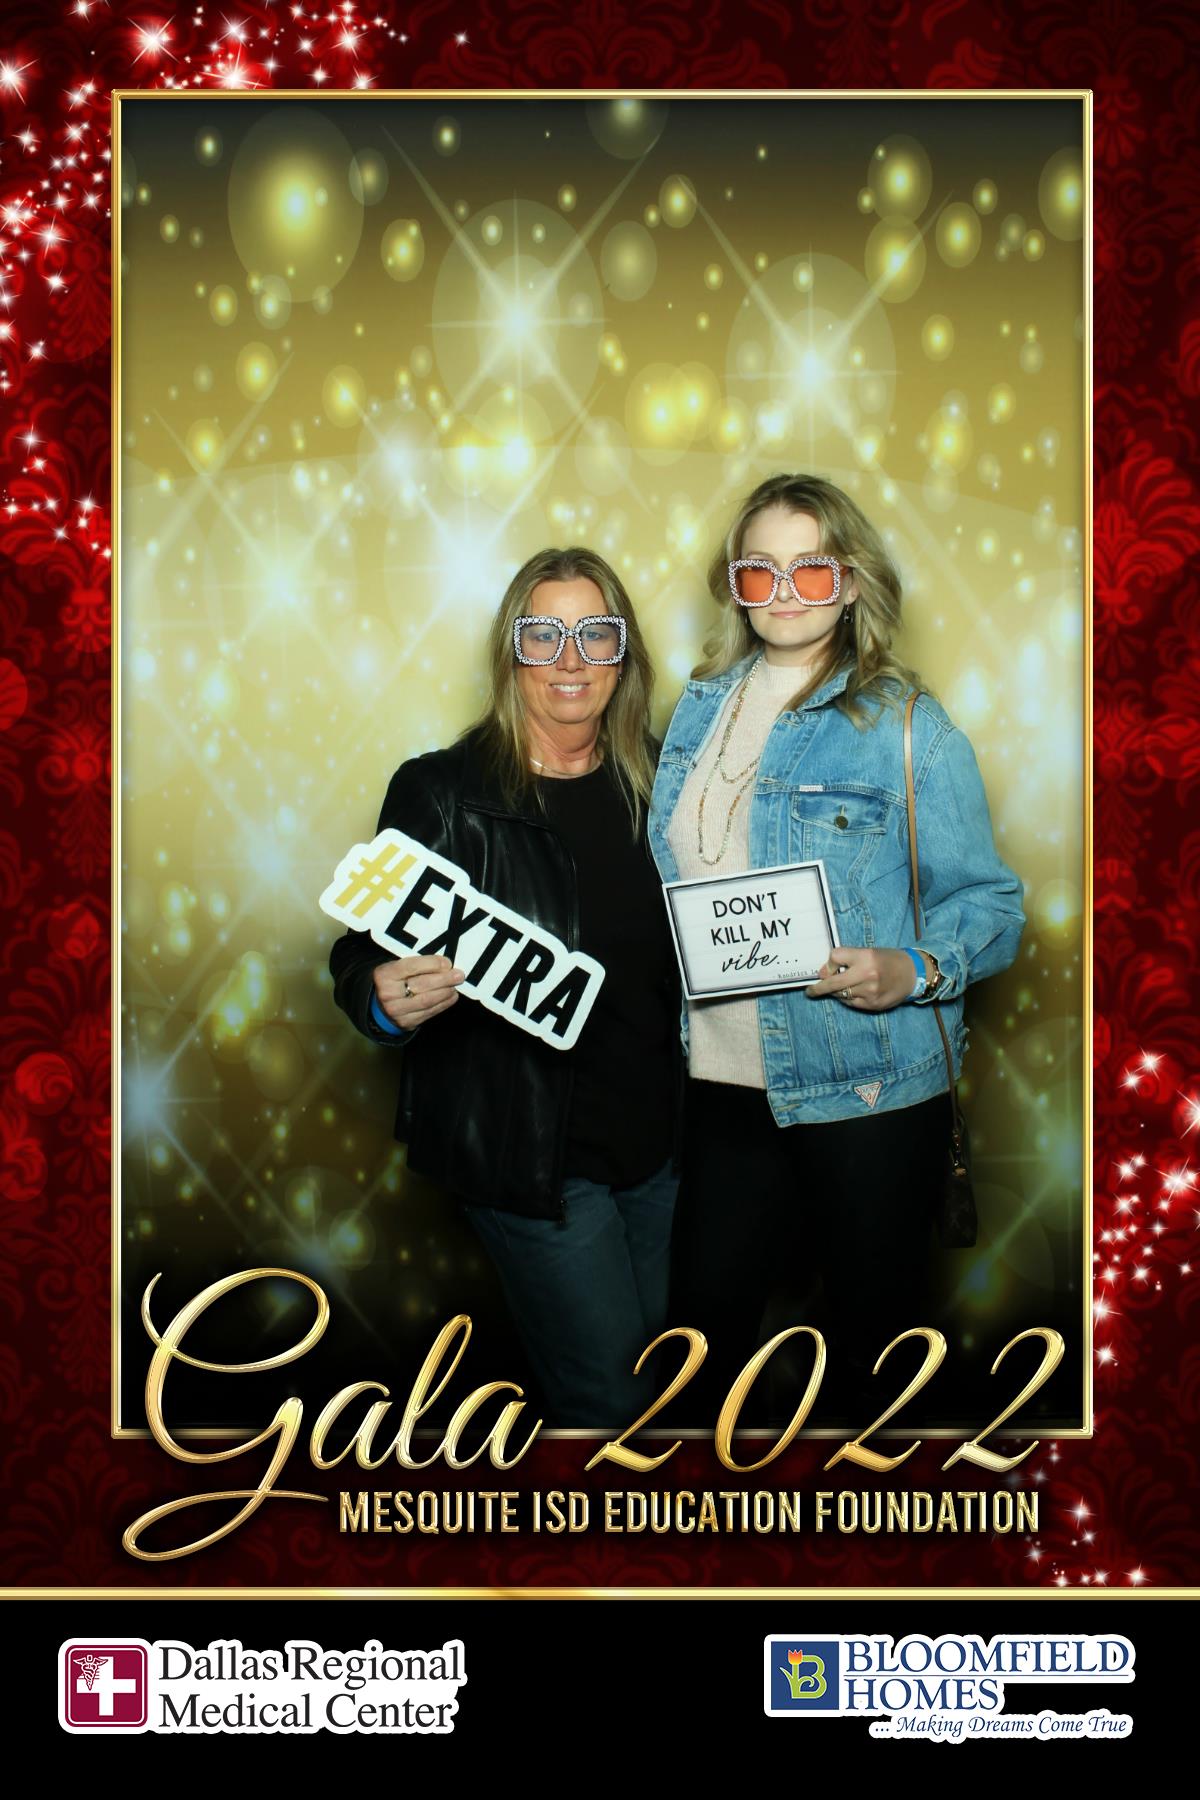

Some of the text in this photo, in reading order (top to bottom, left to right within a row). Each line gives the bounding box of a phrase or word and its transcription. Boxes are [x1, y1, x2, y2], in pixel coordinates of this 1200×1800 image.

[712, 891, 777, 918] DON'T
[334, 842, 591, 1038] #EXTRA
[710, 918, 791, 946] KILL MY
[722, 941, 798, 973] vibe...
